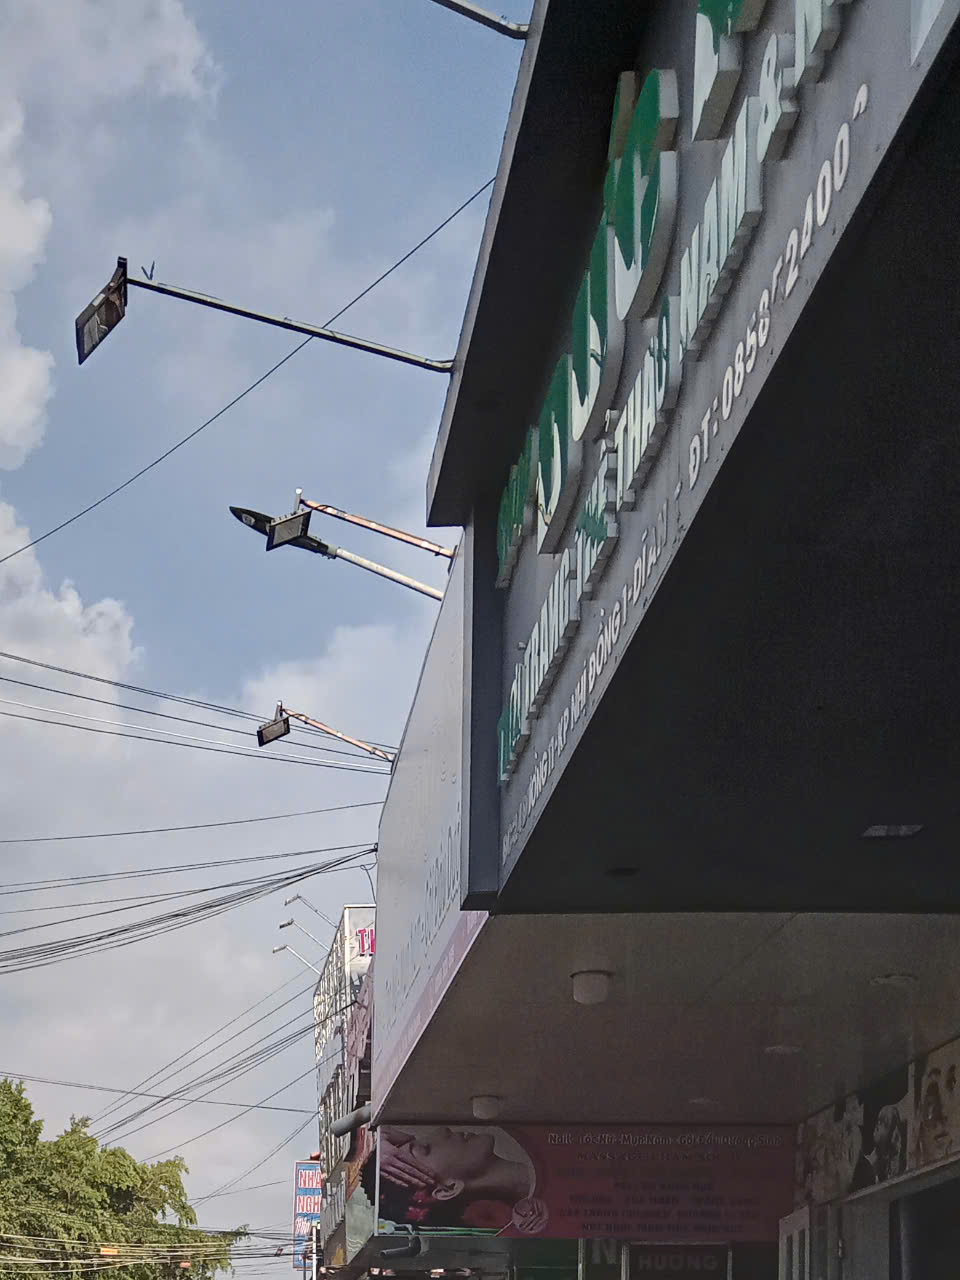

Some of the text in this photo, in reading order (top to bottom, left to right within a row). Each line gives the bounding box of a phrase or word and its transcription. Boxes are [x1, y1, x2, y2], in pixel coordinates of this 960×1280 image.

[524, 549, 570, 718] TRANG
[615, 297, 670, 512] THAO
[679, 96, 748, 346] NAM
[757, 33, 783, 163] &
[589, 601, 621, 693] ĐỒNG
